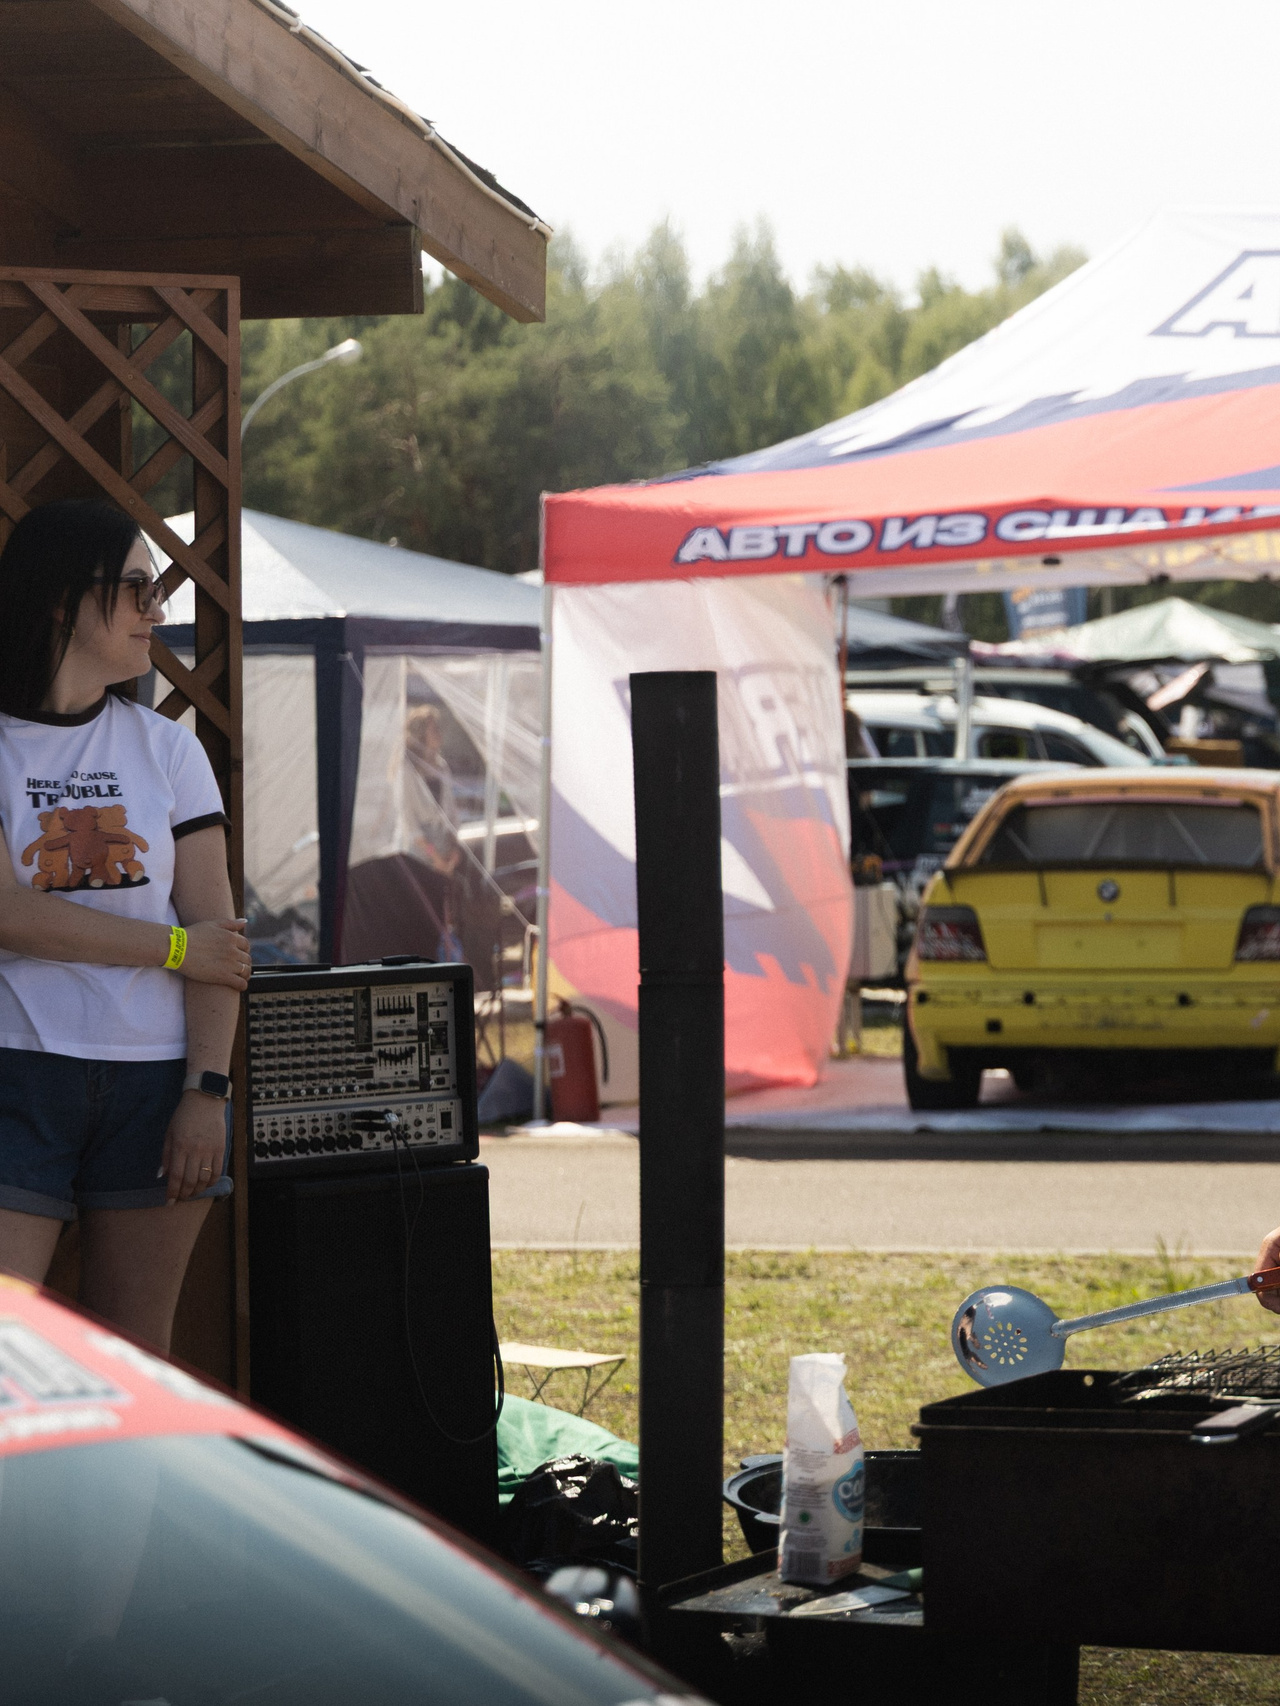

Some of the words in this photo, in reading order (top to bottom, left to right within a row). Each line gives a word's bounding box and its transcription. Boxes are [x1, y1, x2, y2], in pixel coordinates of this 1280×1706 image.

[675, 524, 873, 564] АВТО
[878, 512, 989, 553] ИЗ
[995, 505, 1169, 541] США
[26, 777, 61, 789] HERE
[65, 770, 79, 782] O
[80, 771, 118, 781] CAUSE
[25, 783, 123, 808] TROUBLE
